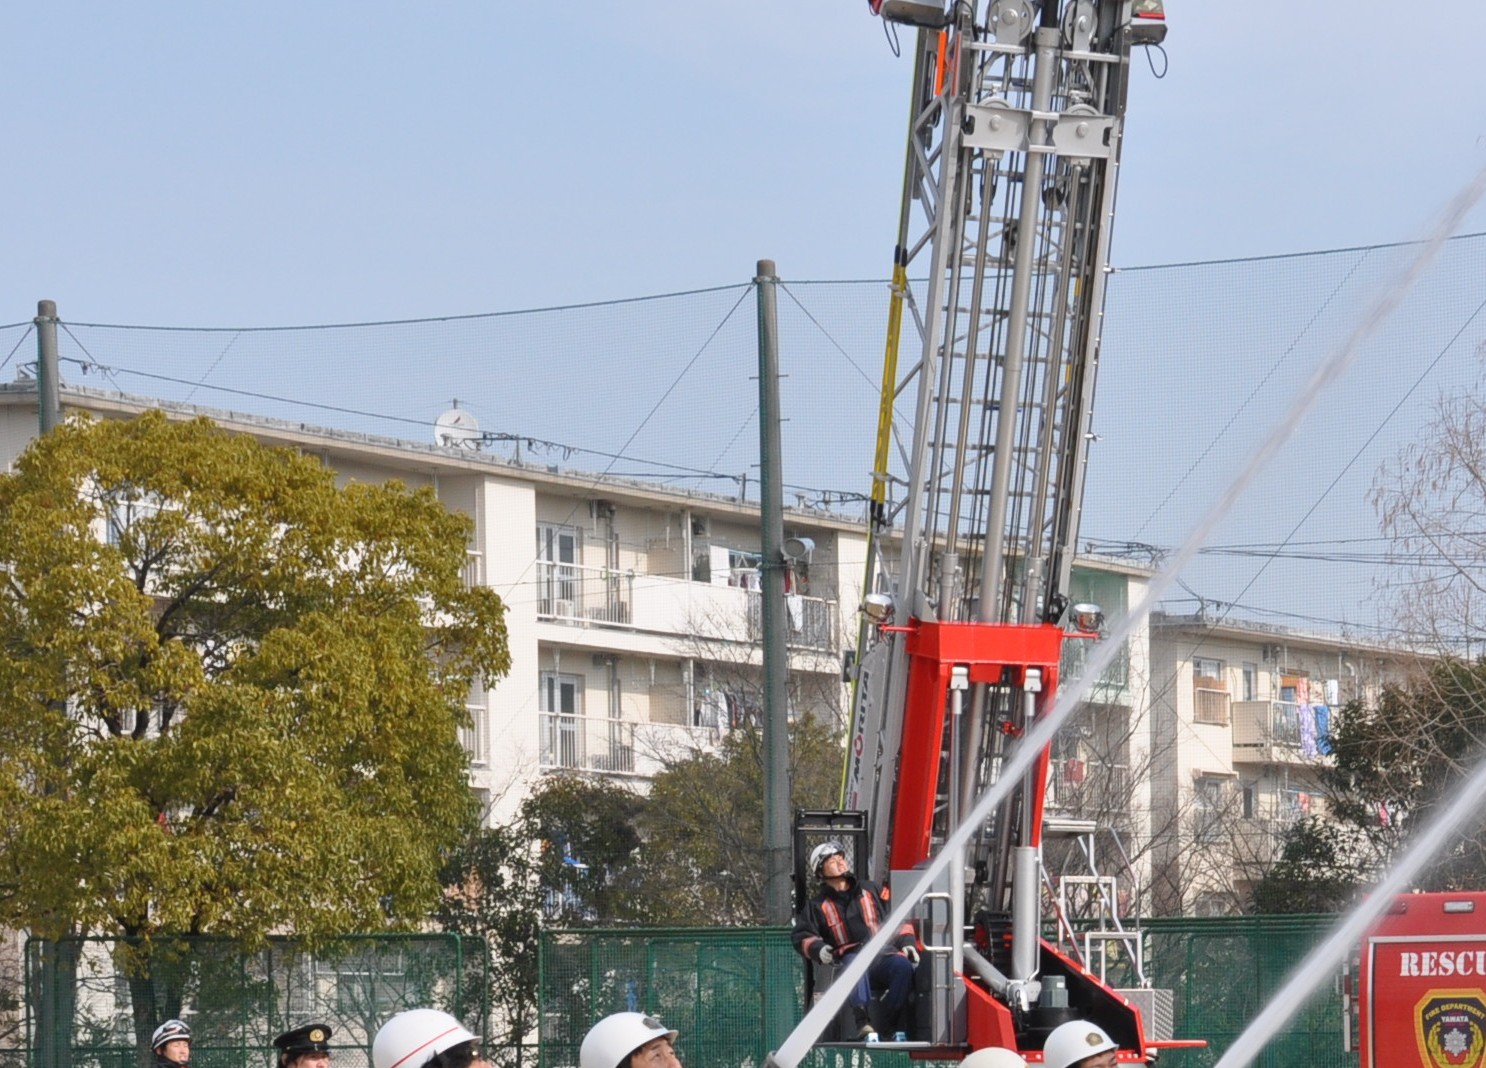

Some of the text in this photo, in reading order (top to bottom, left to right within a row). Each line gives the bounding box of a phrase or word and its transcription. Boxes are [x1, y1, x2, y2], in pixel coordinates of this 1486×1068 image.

[853, 671, 870, 784] MORITA
[1425, 1003, 1486, 1020] FIRE DEPARTMENT
[1441, 1015, 1470, 1023] YAWATA
